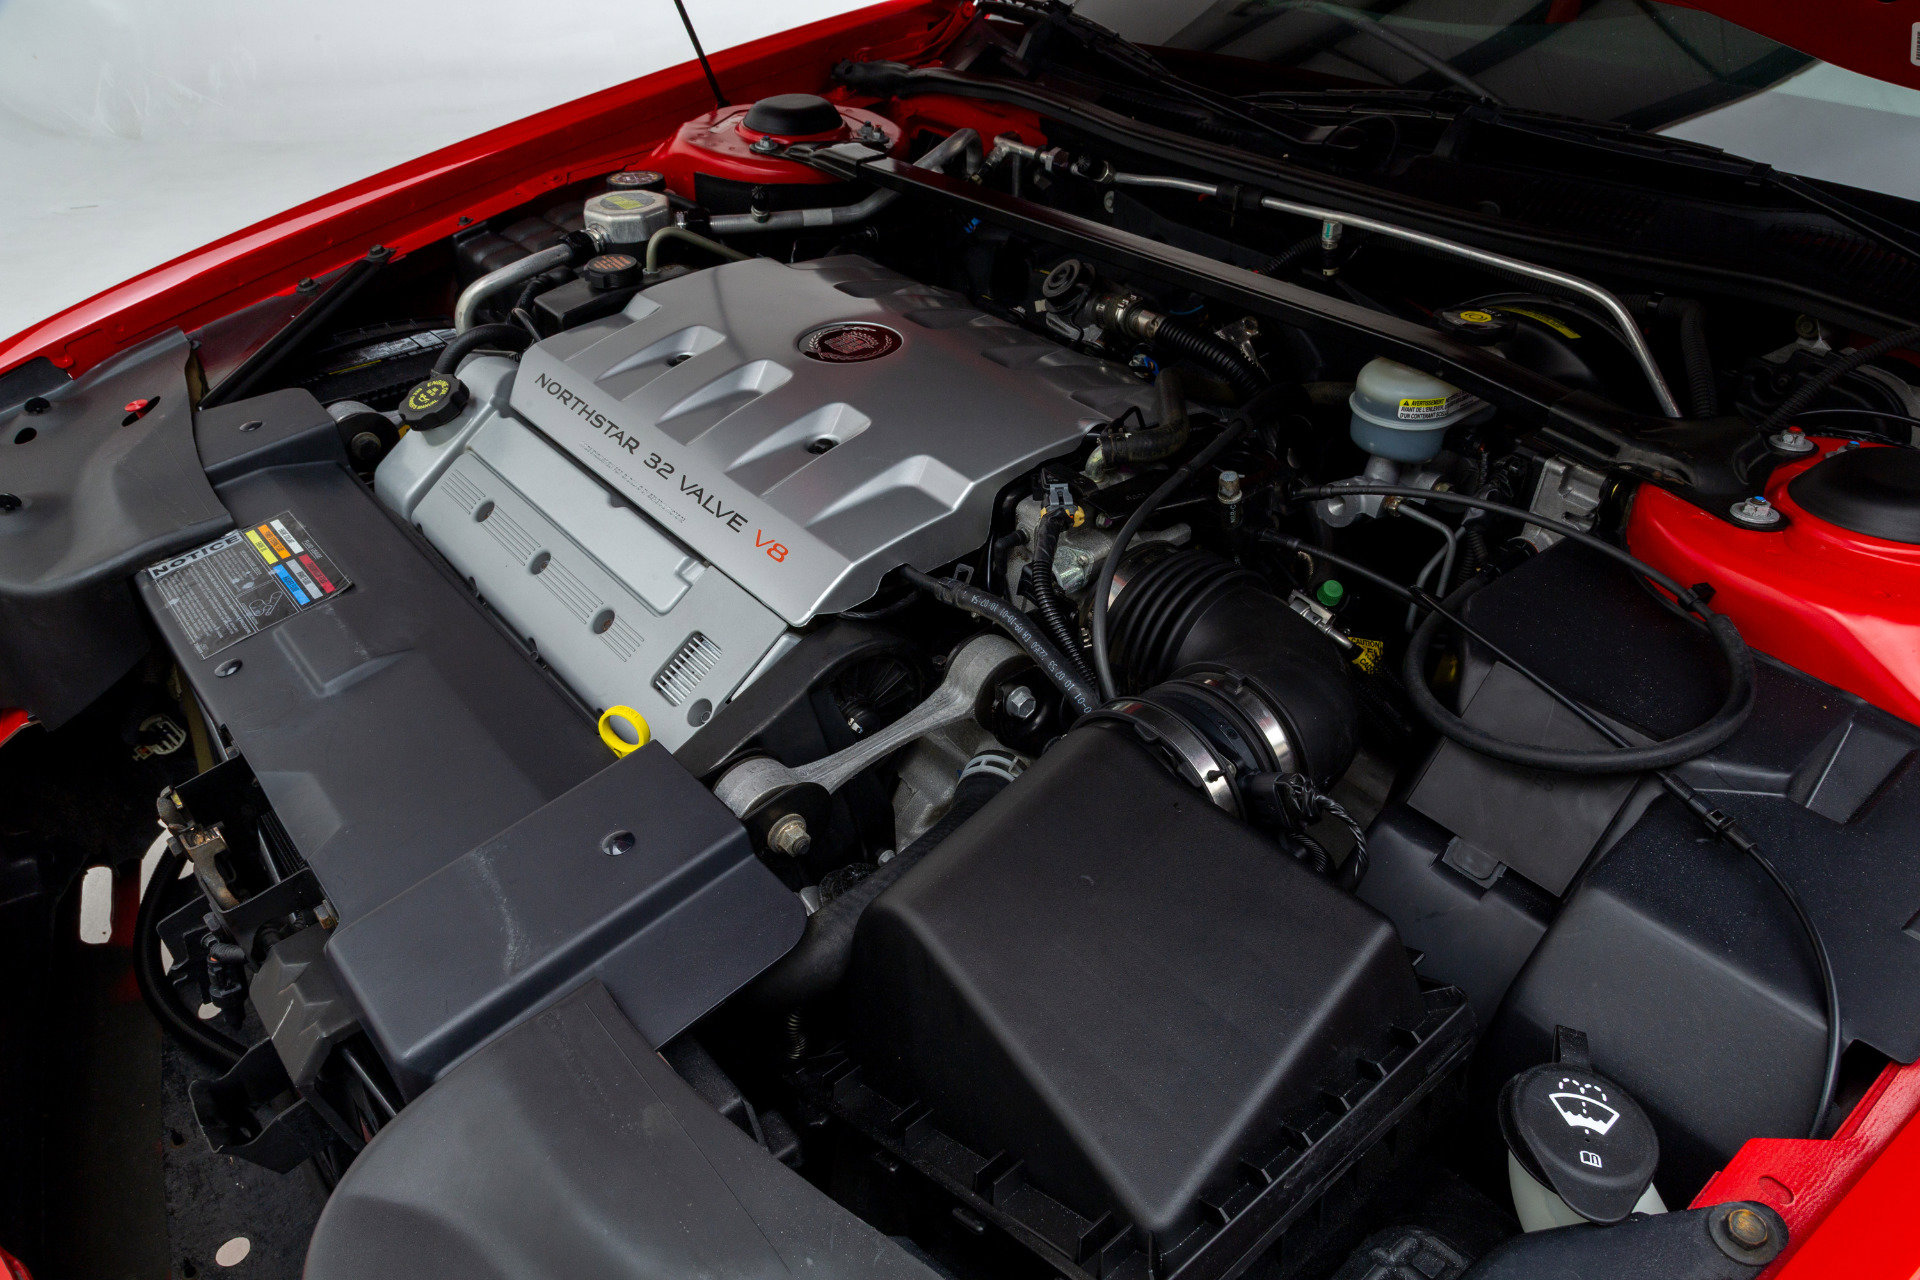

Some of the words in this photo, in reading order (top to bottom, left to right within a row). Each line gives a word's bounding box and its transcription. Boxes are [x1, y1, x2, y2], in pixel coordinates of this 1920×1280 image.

[1410, 398, 1444, 406] AVERTISSEMENT
[534, 372, 640, 455] NORTHSTAR
[643, 452, 675, 480] 32
[680, 475, 748, 533] VALVE
[754, 529, 789, 563] V8
[153, 536, 240, 576] NOTICE
